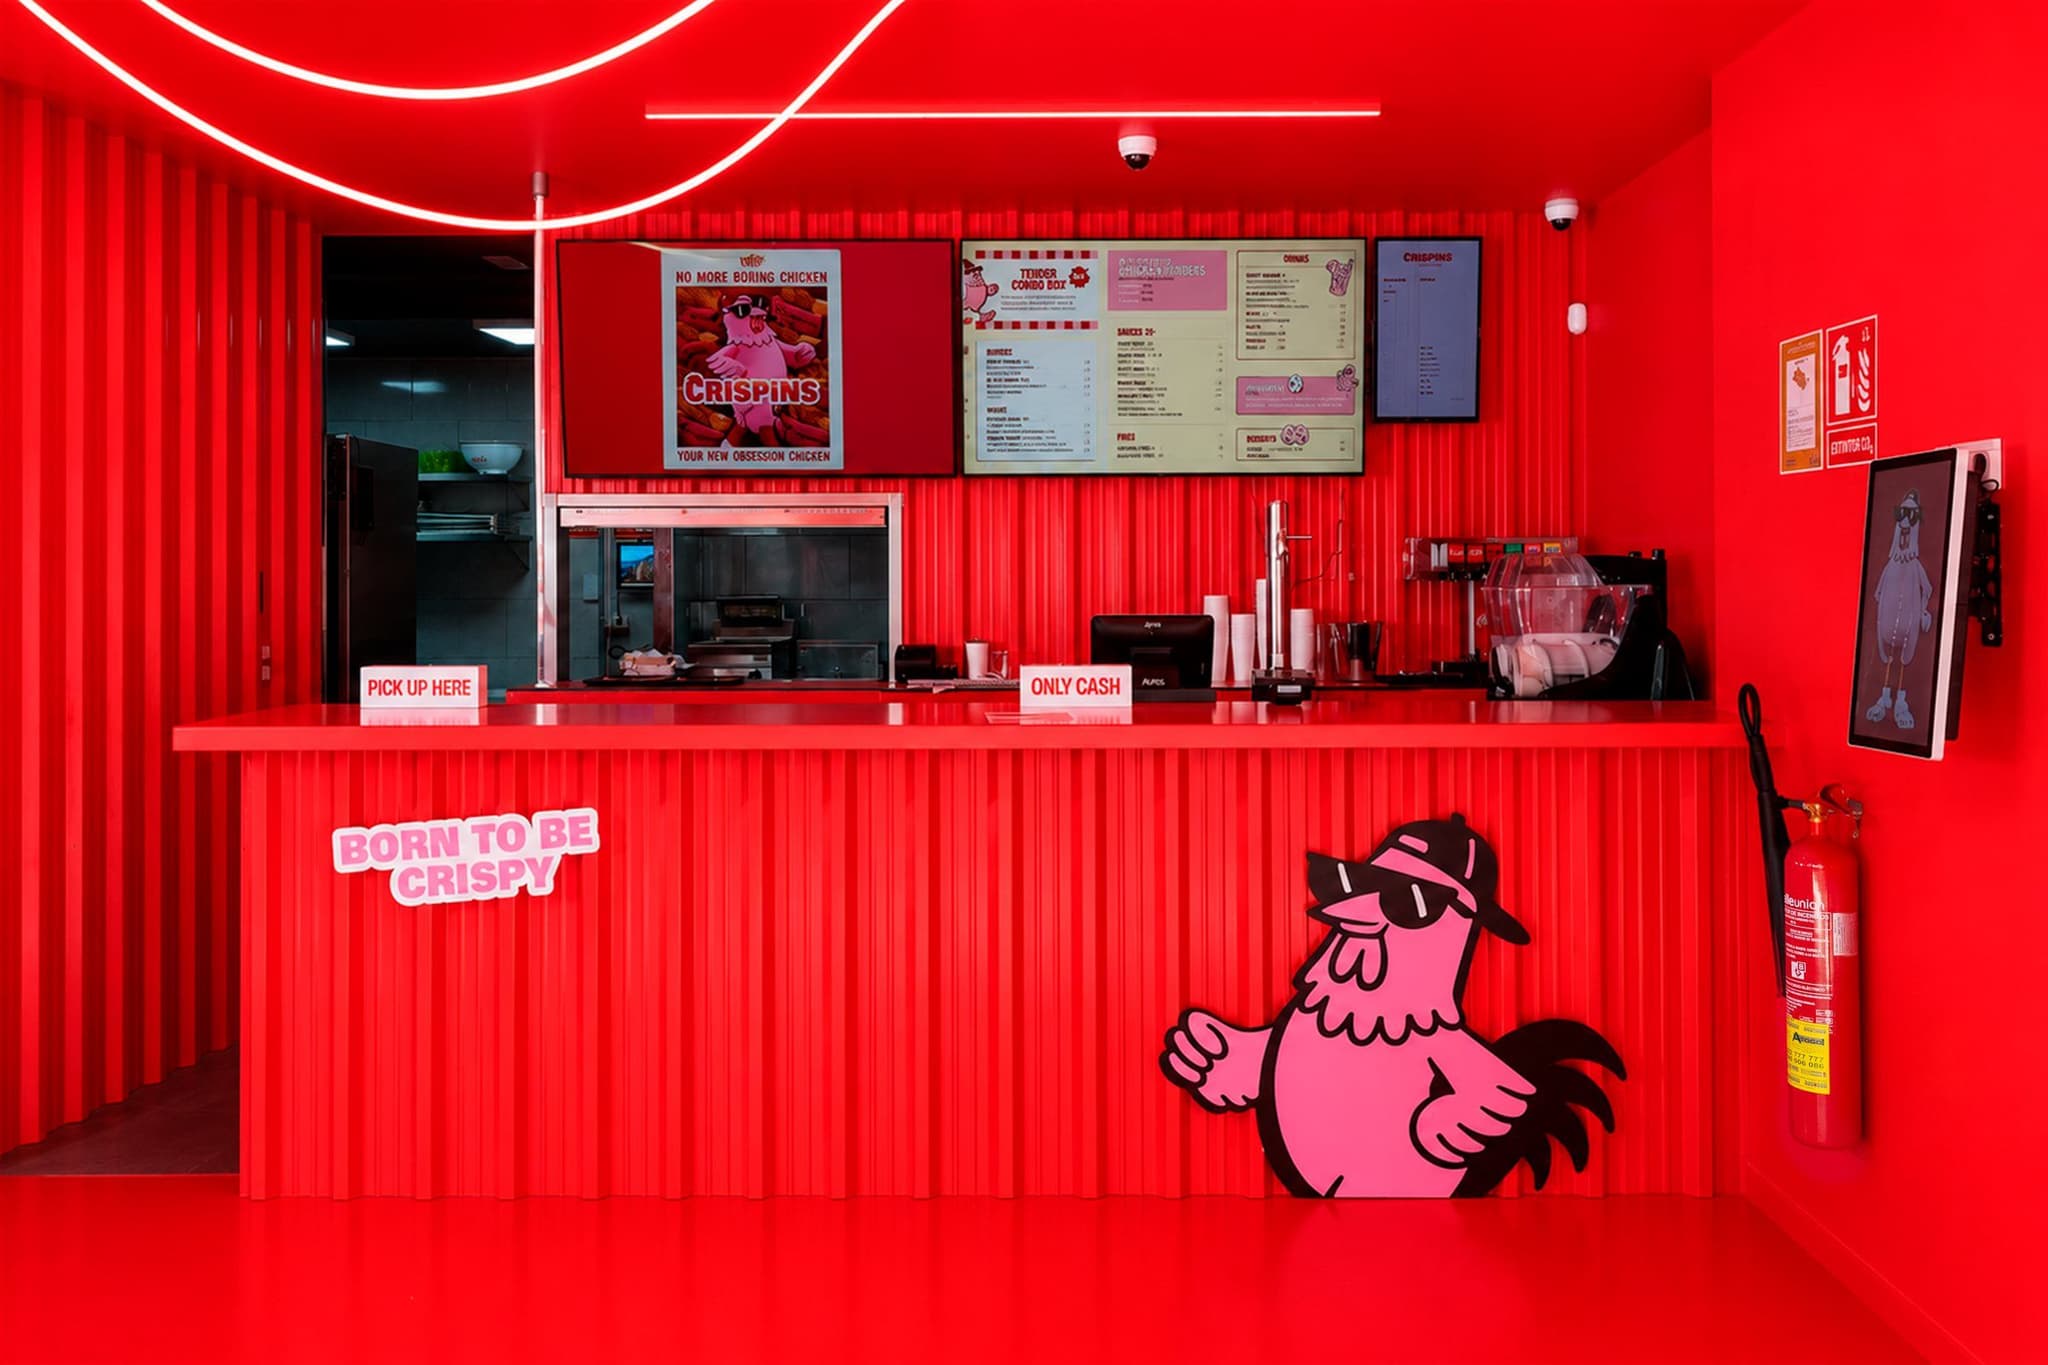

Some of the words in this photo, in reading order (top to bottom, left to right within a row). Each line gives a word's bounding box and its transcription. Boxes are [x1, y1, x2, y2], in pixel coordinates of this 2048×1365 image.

[1403, 252, 1453, 263] CRISPINS
[675, 271, 692, 283] NO
[697, 271, 728, 283] MORE
[733, 271, 775, 284] BORING
[780, 271, 828, 284] CHICKEN
[684, 373, 820, 404] CRISPINS
[677, 450, 703, 462] YOUR
[707, 450, 728, 462] NEW
[732, 450, 785, 462] OBSESSION
[789, 450, 831, 462] CHICKEN
[367, 679, 403, 697] PICK
[407, 679, 428, 697] UP
[432, 679, 471, 697] HERE
[1030, 677, 1072, 695] ONLY
[1076, 677, 1121, 695] CASH
[339, 827, 460, 866] BORN
[471, 820, 526, 855] TO
[539, 815, 593, 850] BE
[397, 856, 554, 899] CRISPY
